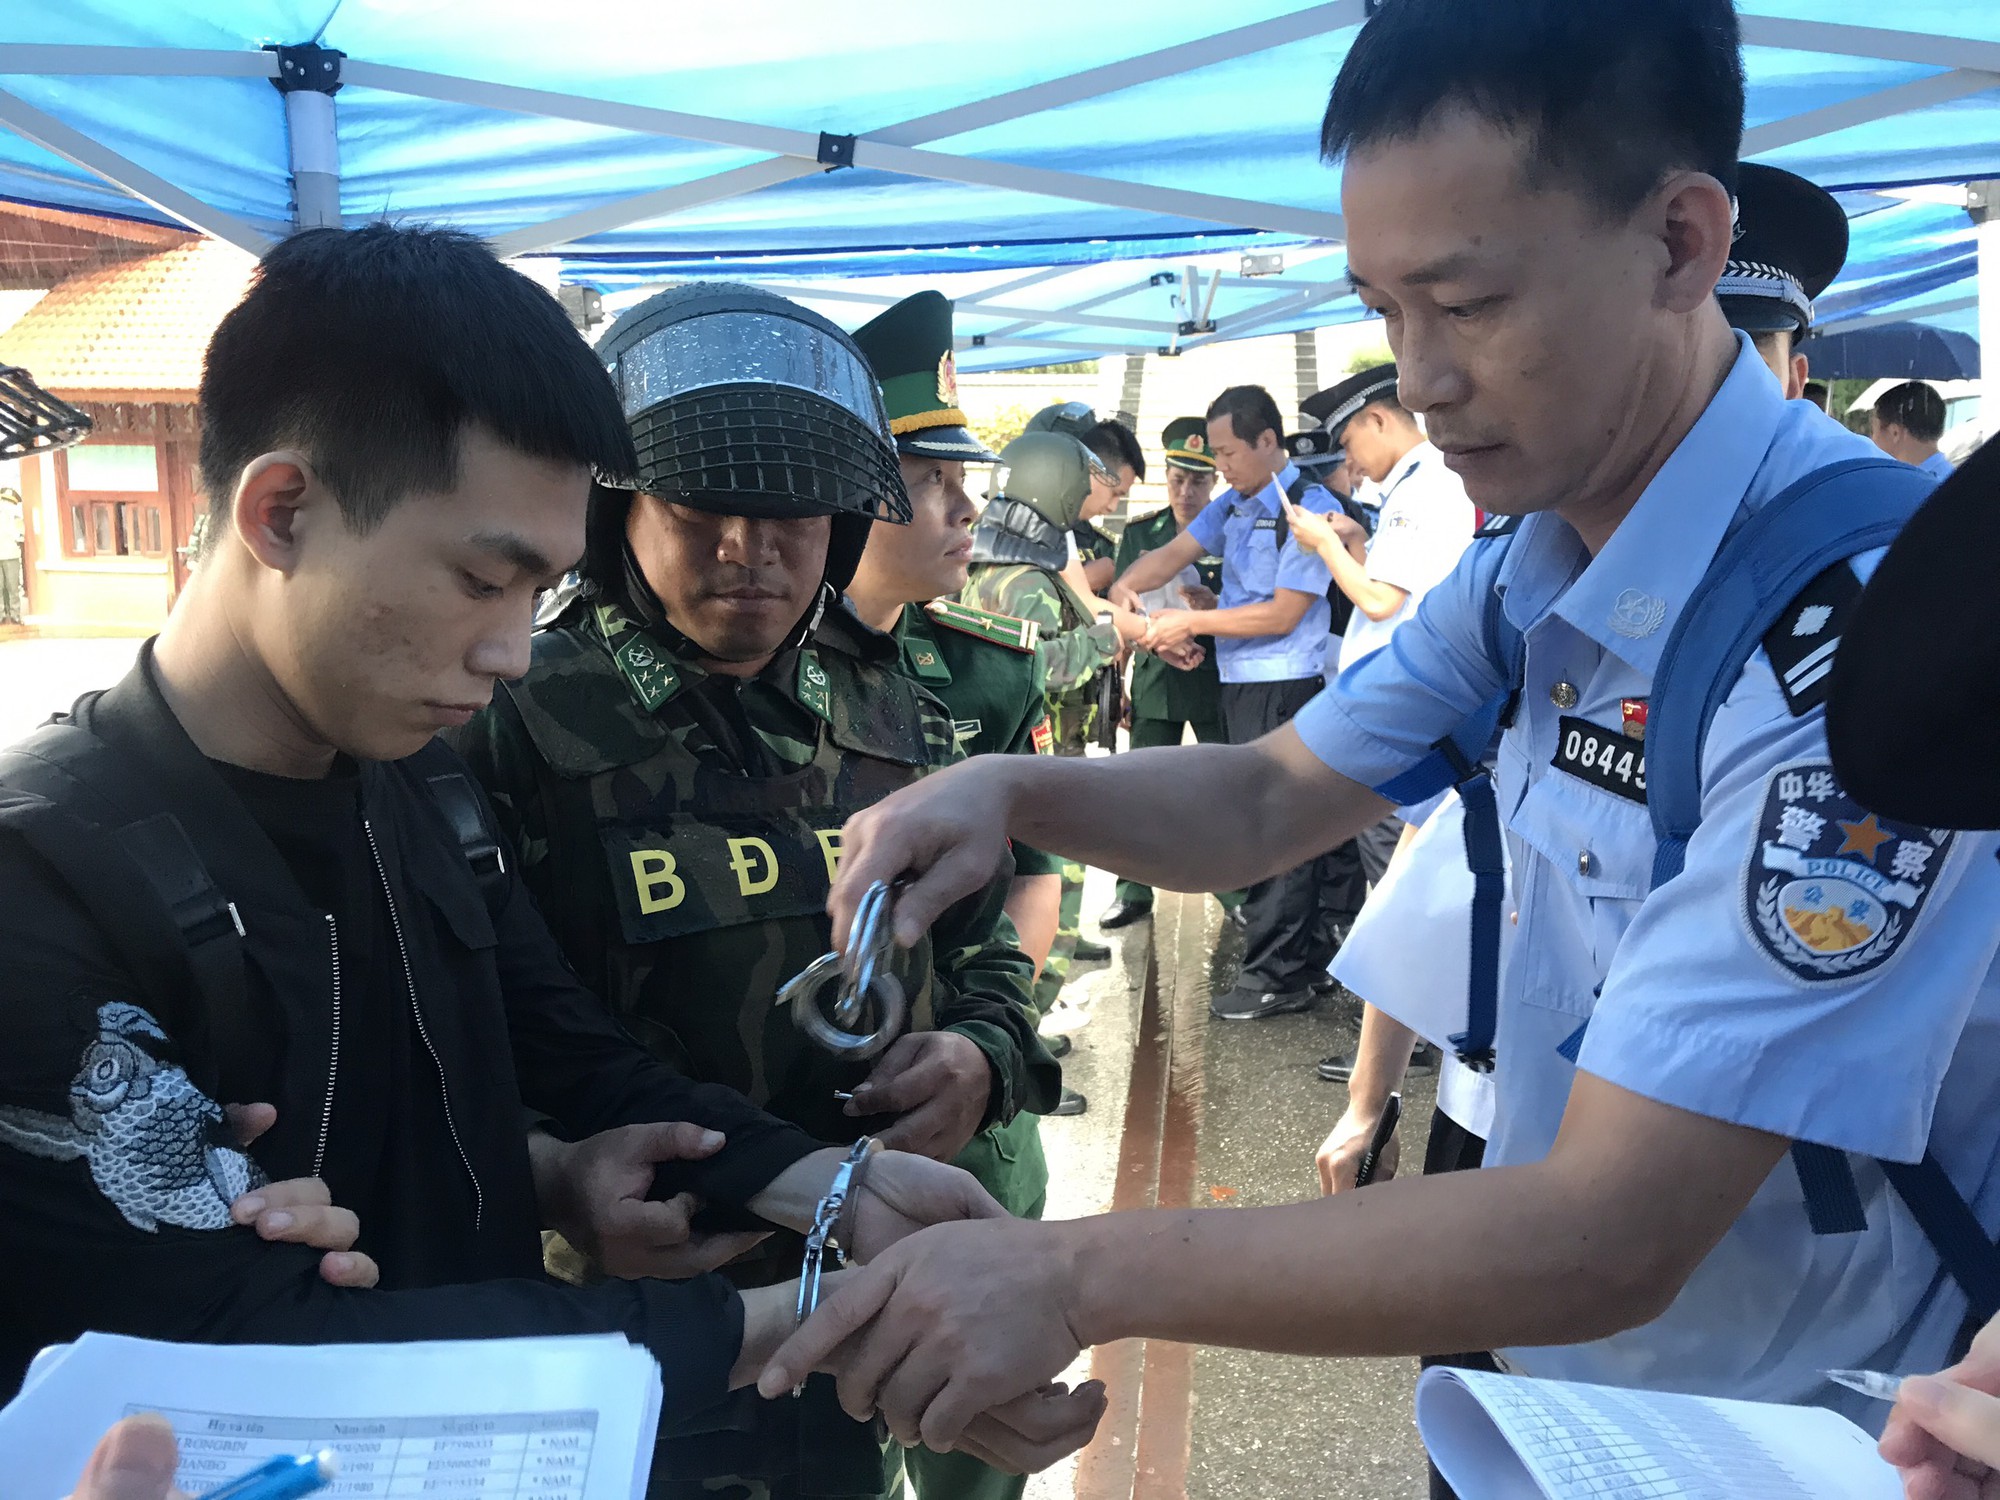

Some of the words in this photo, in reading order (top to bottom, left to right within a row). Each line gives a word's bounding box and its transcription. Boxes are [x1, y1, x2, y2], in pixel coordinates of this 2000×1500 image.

[1778, 771, 1847, 803] 中华
[629, 849, 686, 915] B
[1807, 859, 1889, 894] POLICE
